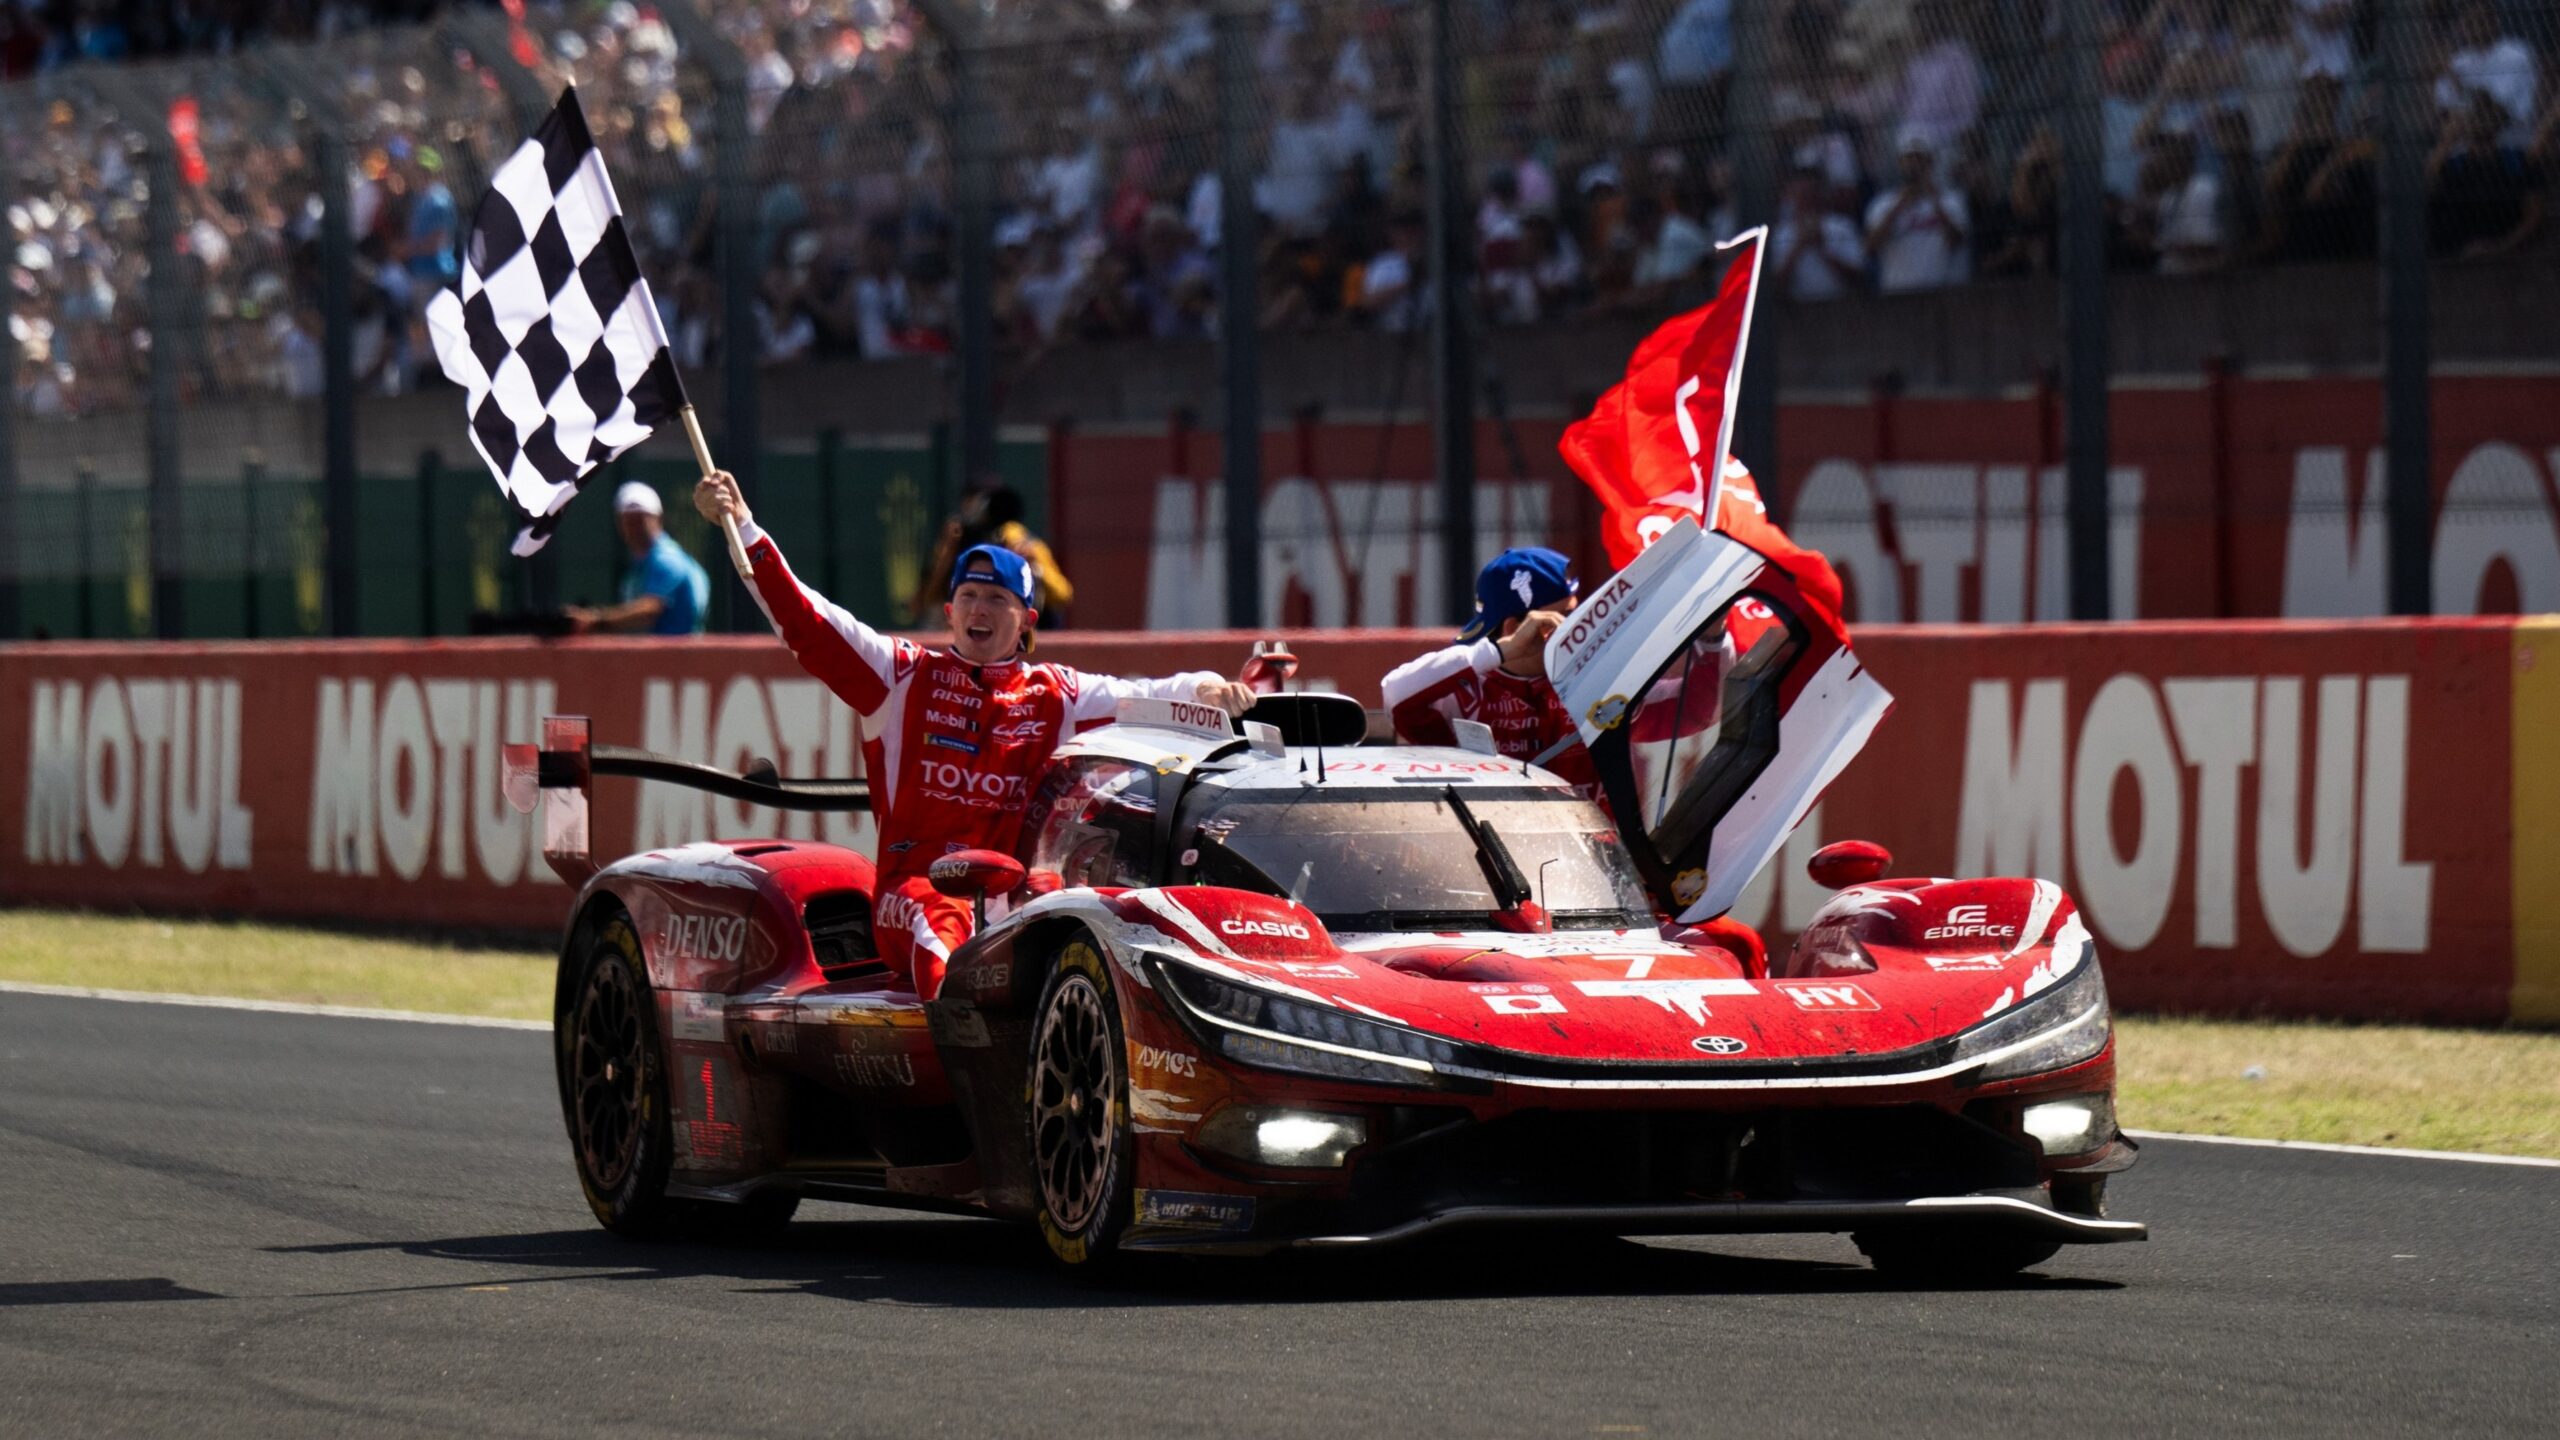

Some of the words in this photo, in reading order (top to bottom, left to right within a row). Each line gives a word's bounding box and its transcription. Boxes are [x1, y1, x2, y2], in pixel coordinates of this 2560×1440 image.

[1788, 458, 2143, 622] OTU
[1560, 578, 1633, 655] TOYOTA
[932, 688, 983, 709] AISIN
[1007, 704, 1035, 716] ZENT
[926, 710, 966, 730] Mobil
[1171, 703, 1223, 730] TOYOTA
[23, 675, 253, 873] MOTUL
[634, 673, 880, 868] MOTU
[920, 760, 1028, 798] TOYOTA
[1325, 762, 1511, 774] DENSO
[920, 788, 1024, 811] RACING
[1955, 673, 2434, 957] MOTUL
[664, 914, 748, 962] DENSO
[1221, 920, 1310, 940] CASIO
[1924, 924, 2016, 940] EDIFICE
[966, 963, 1009, 990] RAYS
[1785, 987, 1860, 1006] HY
[1161, 1202, 1243, 1220] MICLIN
